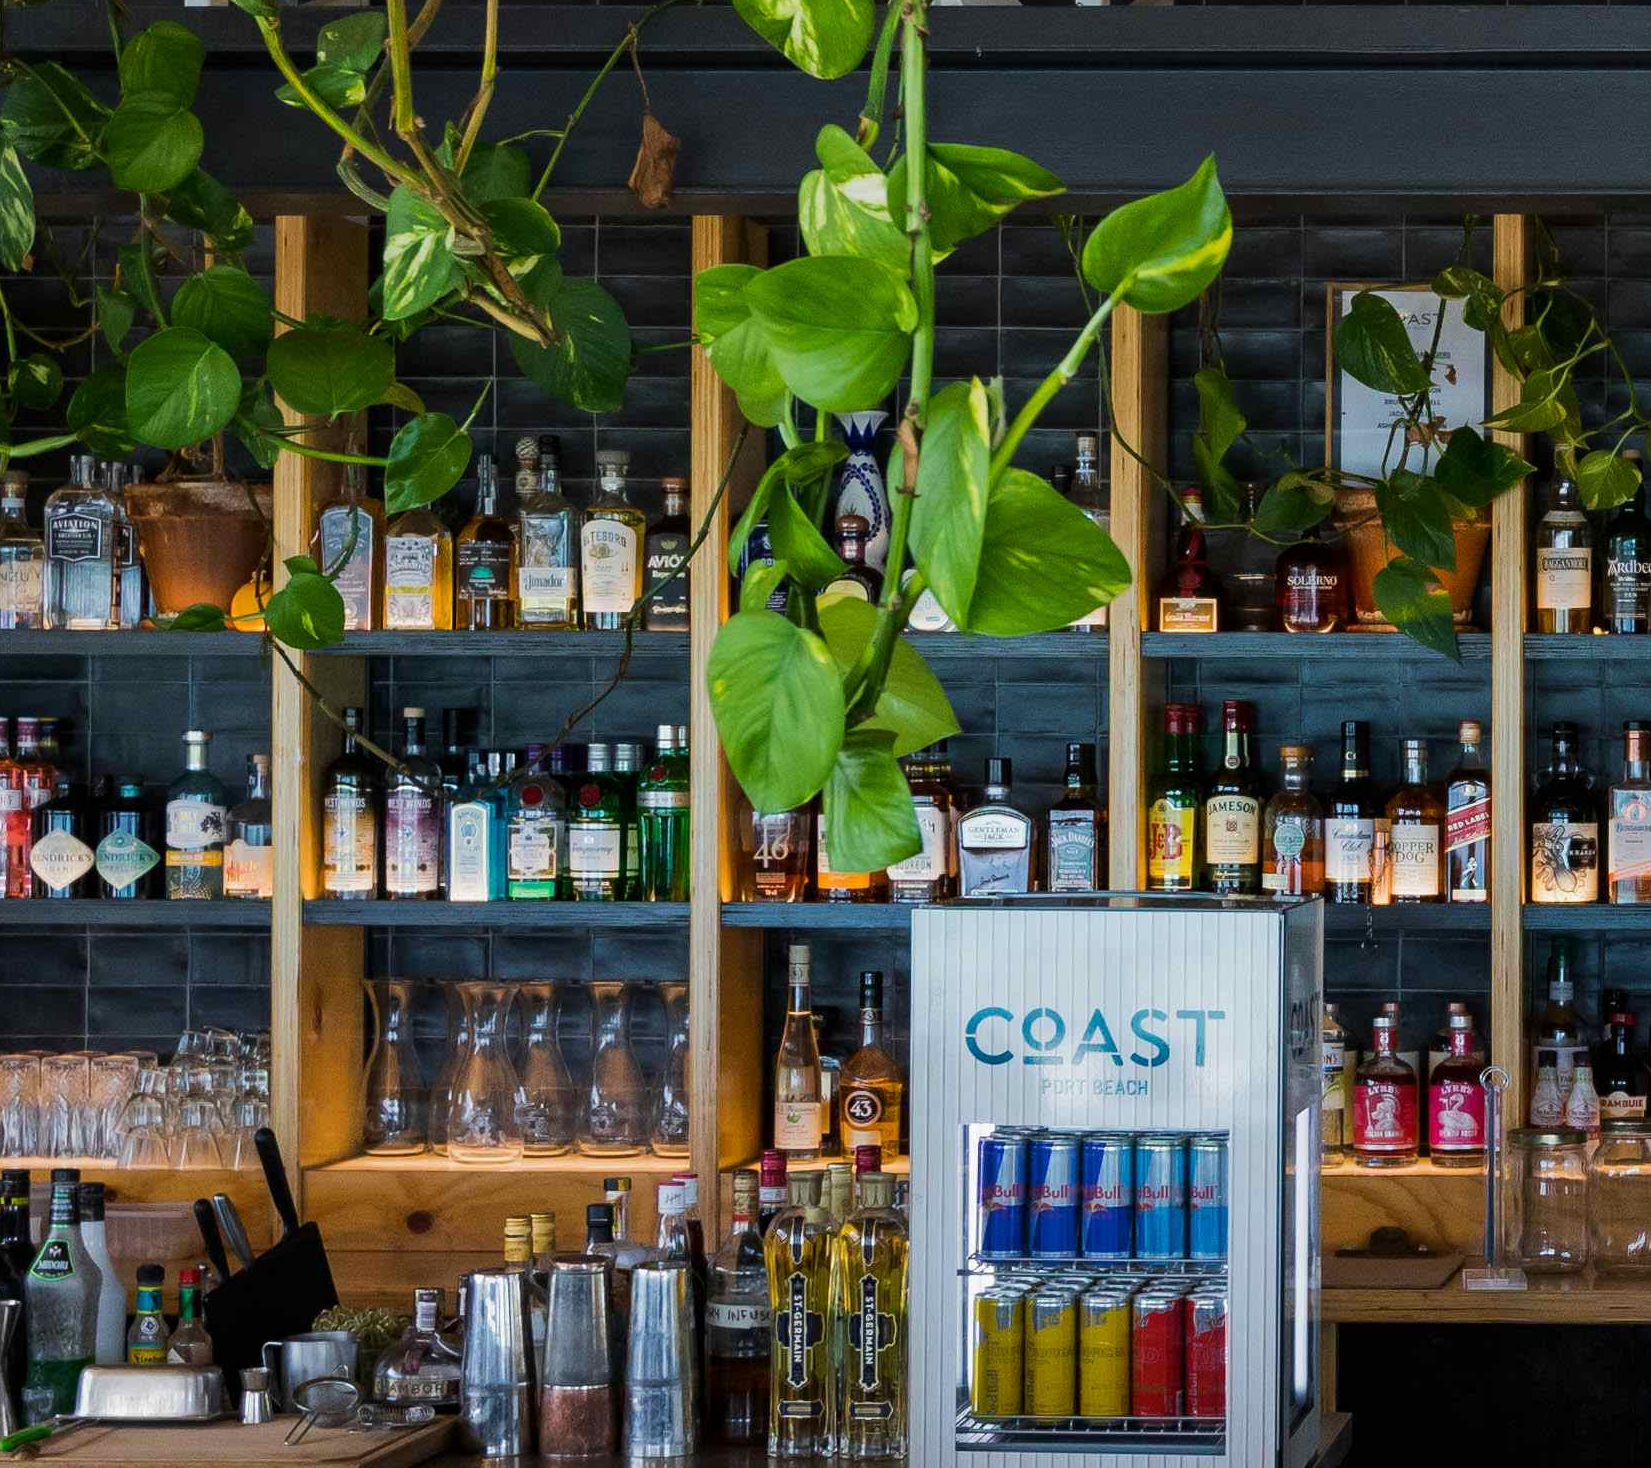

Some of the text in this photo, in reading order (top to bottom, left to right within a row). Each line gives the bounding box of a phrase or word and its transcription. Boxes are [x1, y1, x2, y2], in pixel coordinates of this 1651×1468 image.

[52, 518, 98, 530] AVIATION
[1287, 575, 1338, 587] SOLERNO
[1207, 800, 1257, 816] JAMESON
[1448, 819, 1464, 833] RED
[753, 821, 790, 869] 46
[32, 852, 94, 864] ENDRICK'S
[98, 852, 154, 864] ENDRICK'S
[1395, 851, 1425, 864] DOG
[964, 1006, 1226, 1068] COAST
[1041, 1079, 1149, 1096] PORT BEACH
[849, 1100, 873, 1117] 43
[1599, 1098, 1645, 1109] RAMBUIE
[793, 1293, 804, 1364] ST-GERMAIN
[863, 1291, 875, 1366] ST-GERMAIN
